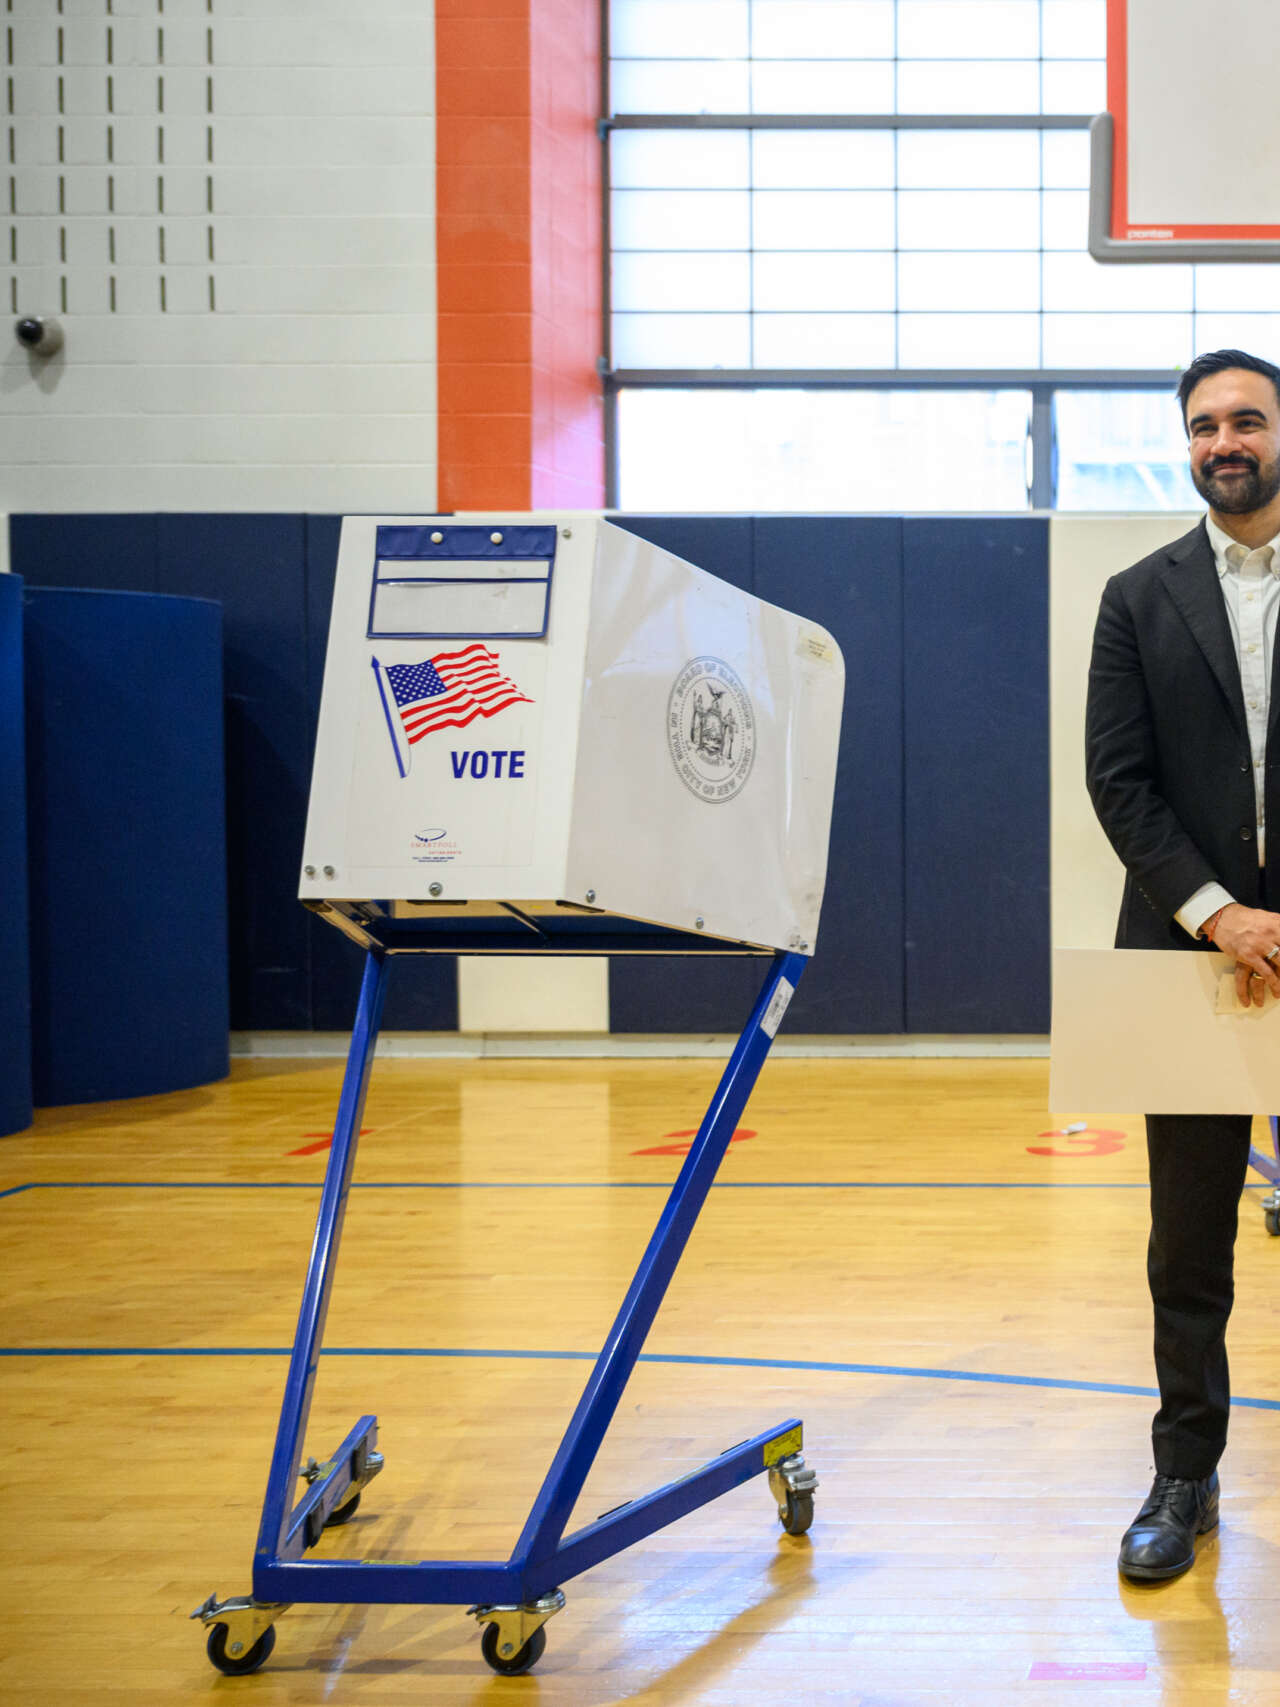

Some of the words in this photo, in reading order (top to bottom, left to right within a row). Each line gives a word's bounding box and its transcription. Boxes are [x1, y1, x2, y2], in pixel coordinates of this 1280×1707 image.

[450, 750, 526, 779] VOTE
[628, 1128, 758, 1156] 2
[1025, 1128, 1129, 1157] 3
